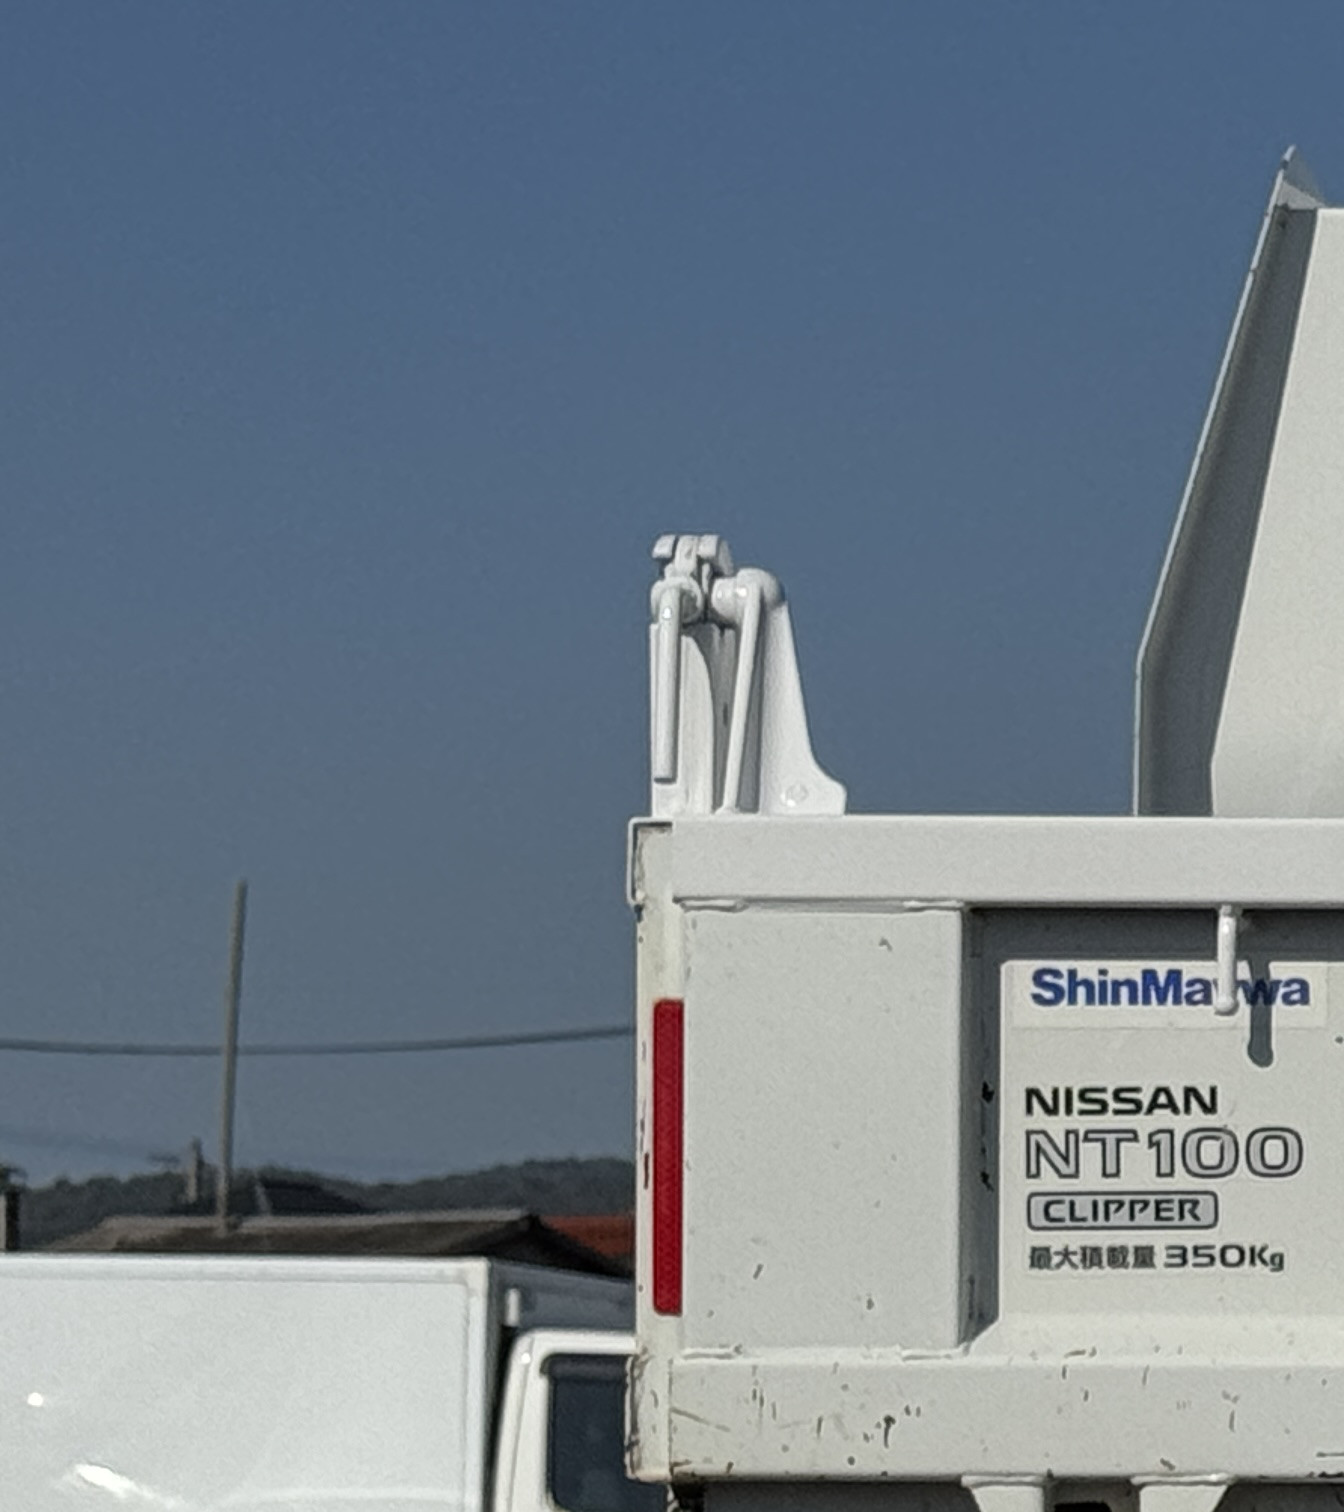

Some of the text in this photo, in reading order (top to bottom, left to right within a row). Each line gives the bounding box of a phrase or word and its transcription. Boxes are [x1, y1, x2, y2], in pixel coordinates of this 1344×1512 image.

[1030, 967, 1311, 1006] ShinMawa
[1025, 1085, 1219, 1117] NISSAN
[1025, 1126, 1304, 1180] NT100
[1042, 1198, 1203, 1224] CLIPPER
[1163, 1244, 1286, 1273] 350Kg
